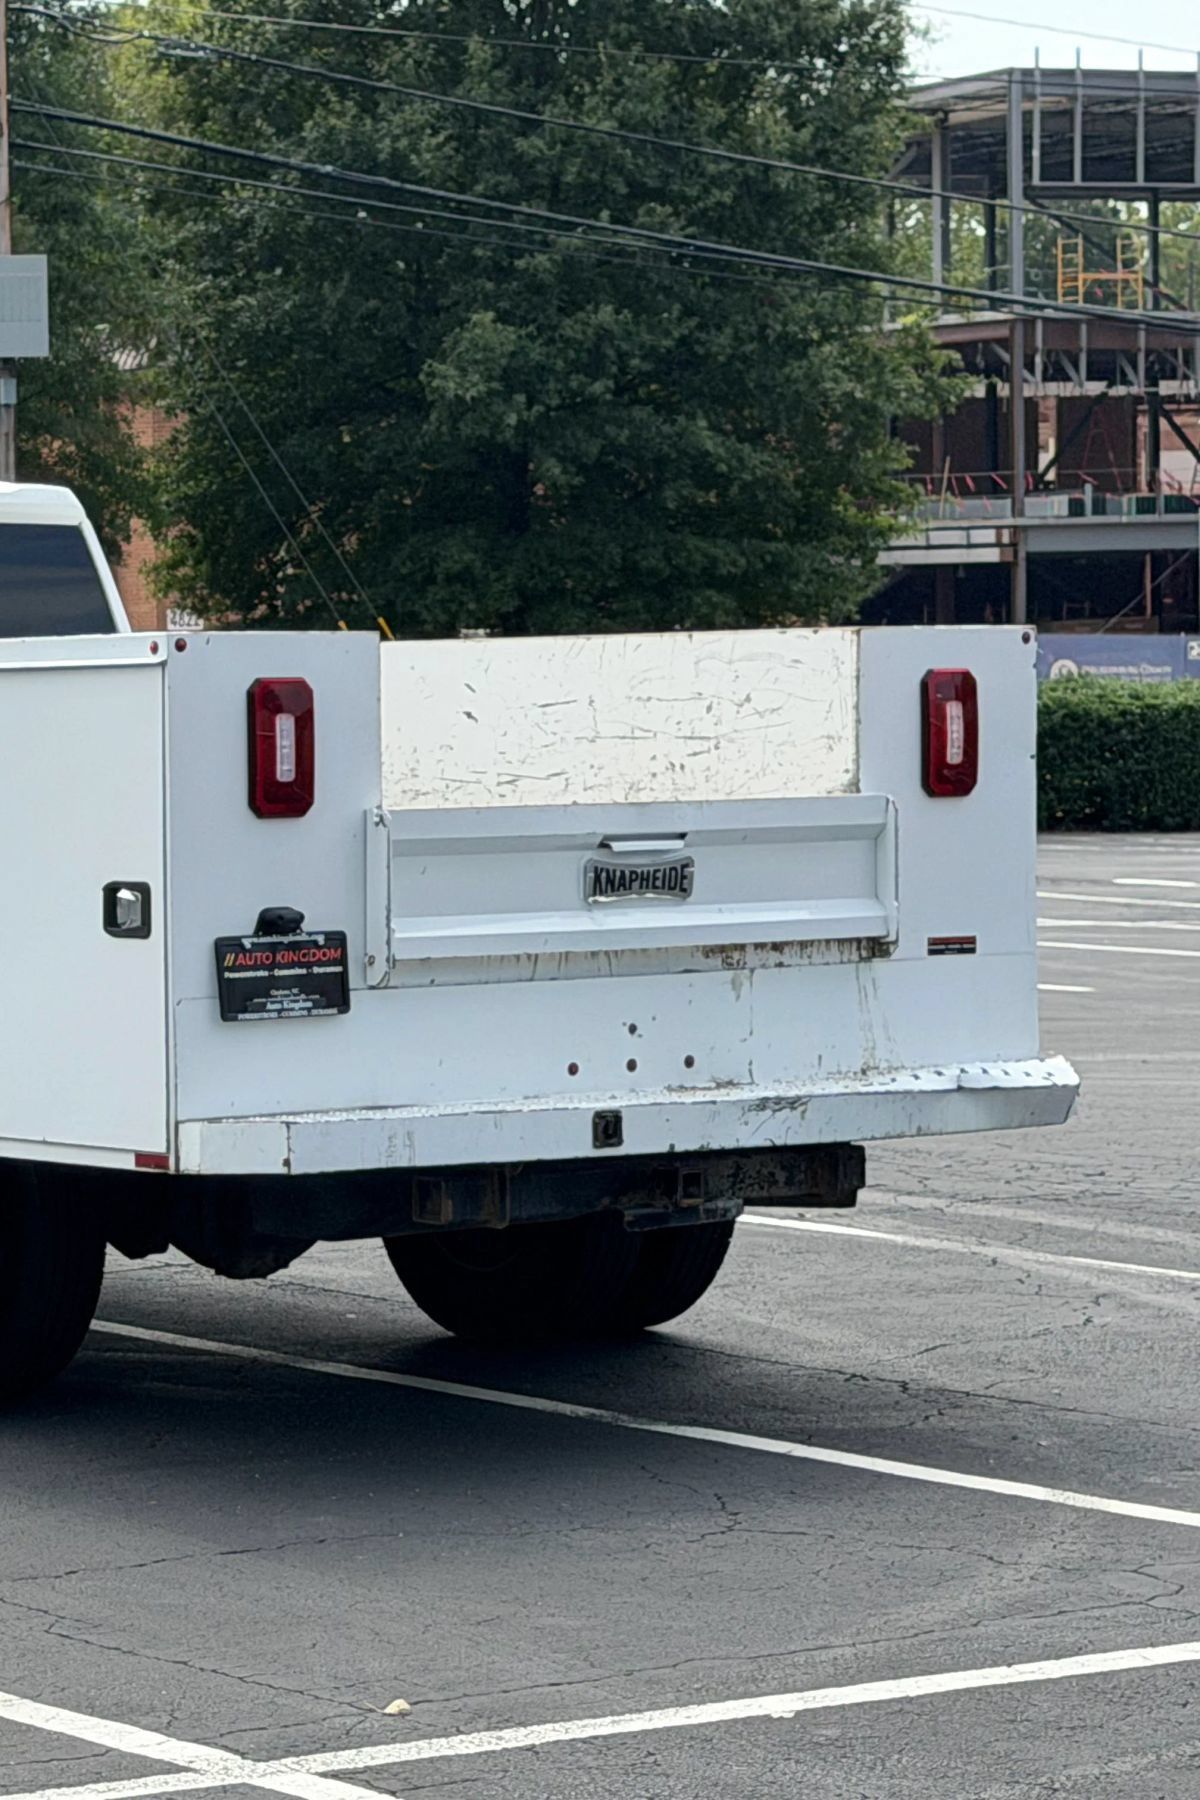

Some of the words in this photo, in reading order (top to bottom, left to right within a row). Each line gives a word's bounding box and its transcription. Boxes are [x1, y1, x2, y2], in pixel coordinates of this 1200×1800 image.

[593, 863, 691, 896] KNAPHEIDE
[235, 951, 273, 966] AUTO
[275, 947, 342, 963] KINGDOM
